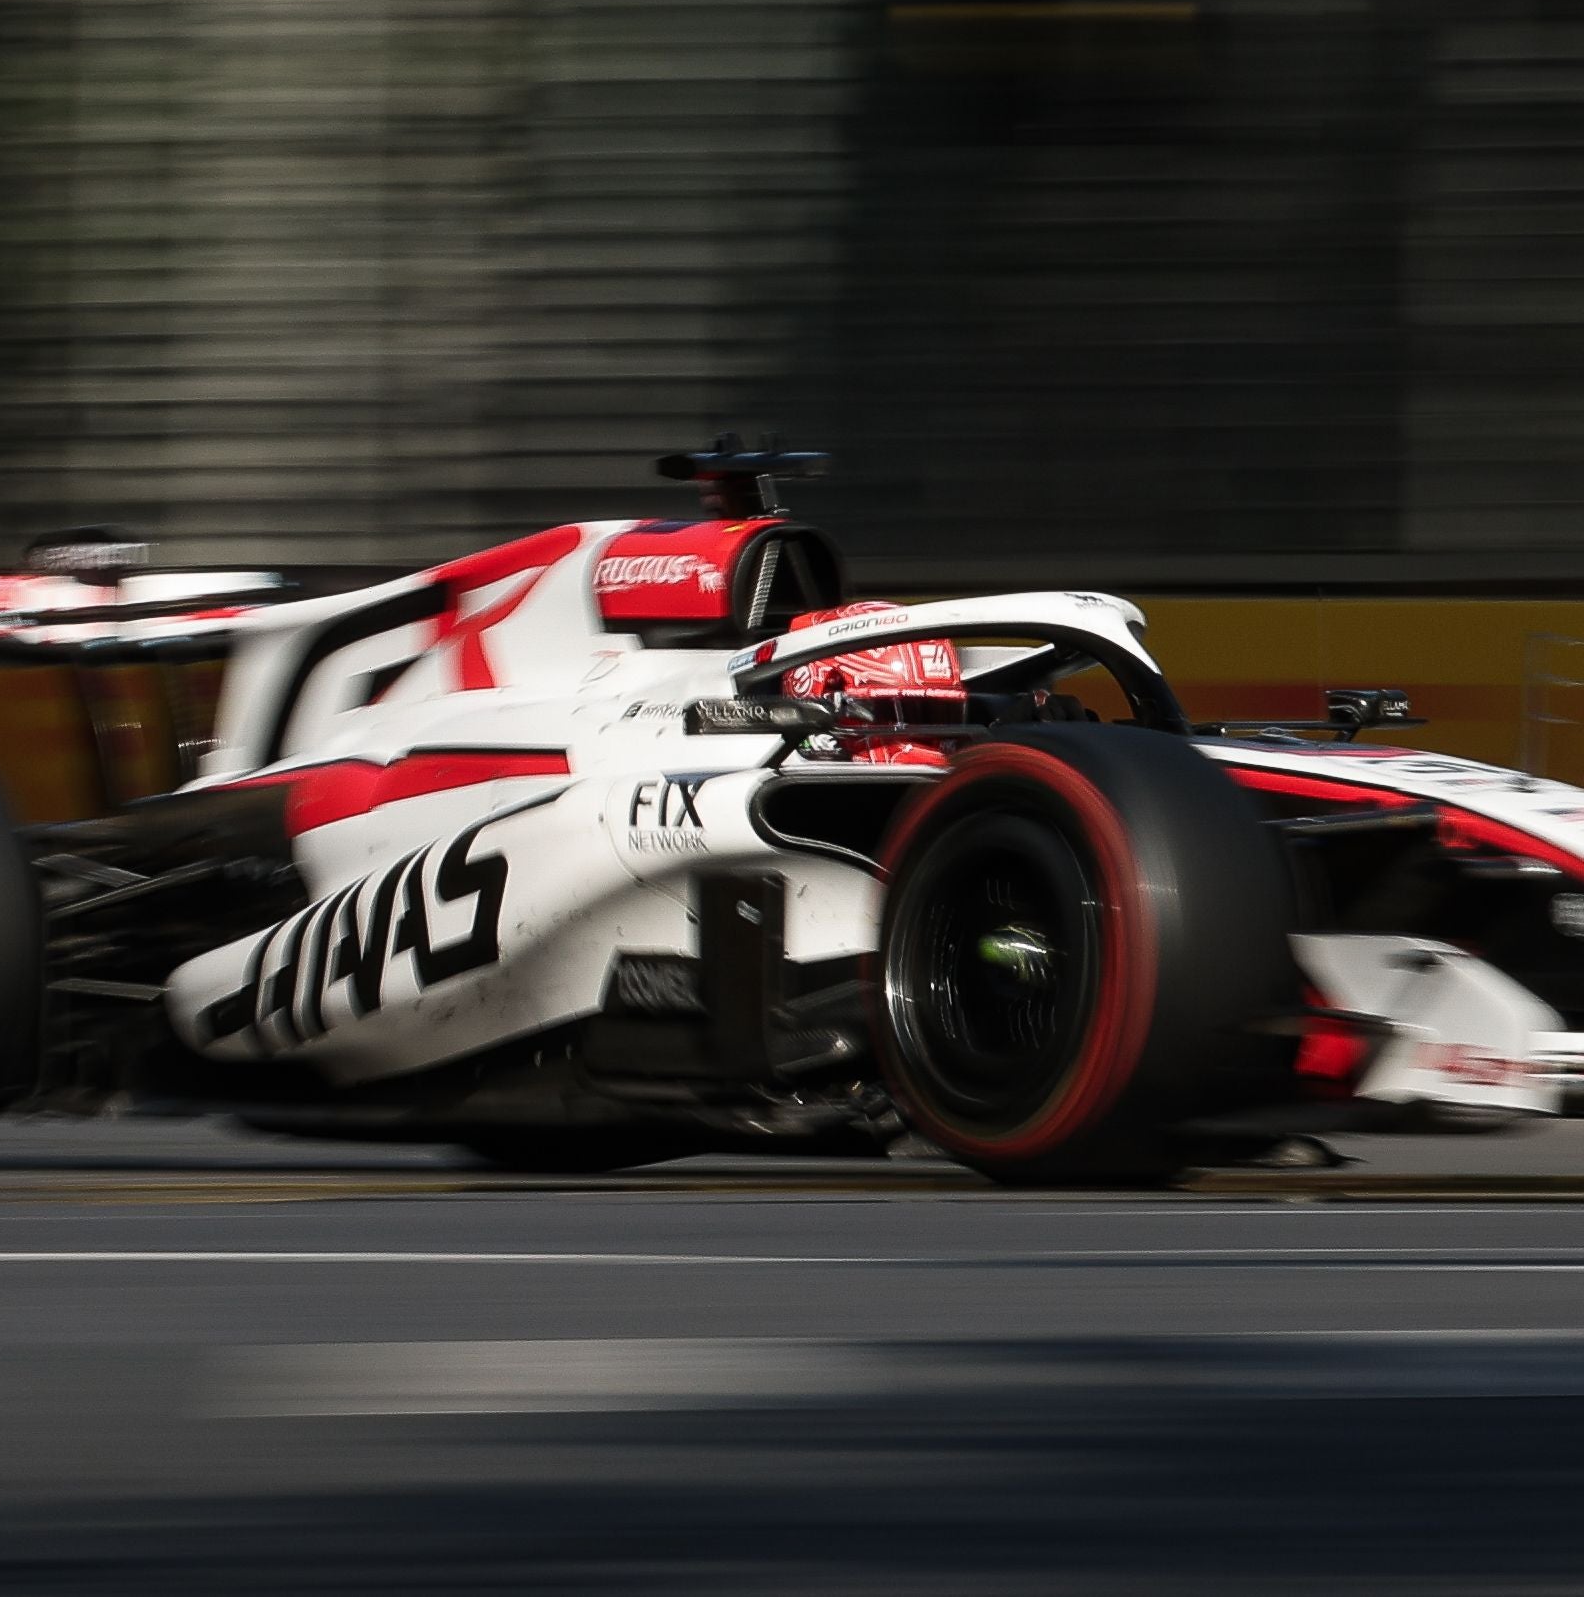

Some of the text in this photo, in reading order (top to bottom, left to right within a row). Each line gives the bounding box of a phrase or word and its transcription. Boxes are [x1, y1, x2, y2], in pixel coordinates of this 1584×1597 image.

[593, 555, 698, 584] RUCKUS
[629, 781, 704, 827] FIX
[629, 830, 710, 853] NETWORK
[195, 785, 571, 1056] HAAS
